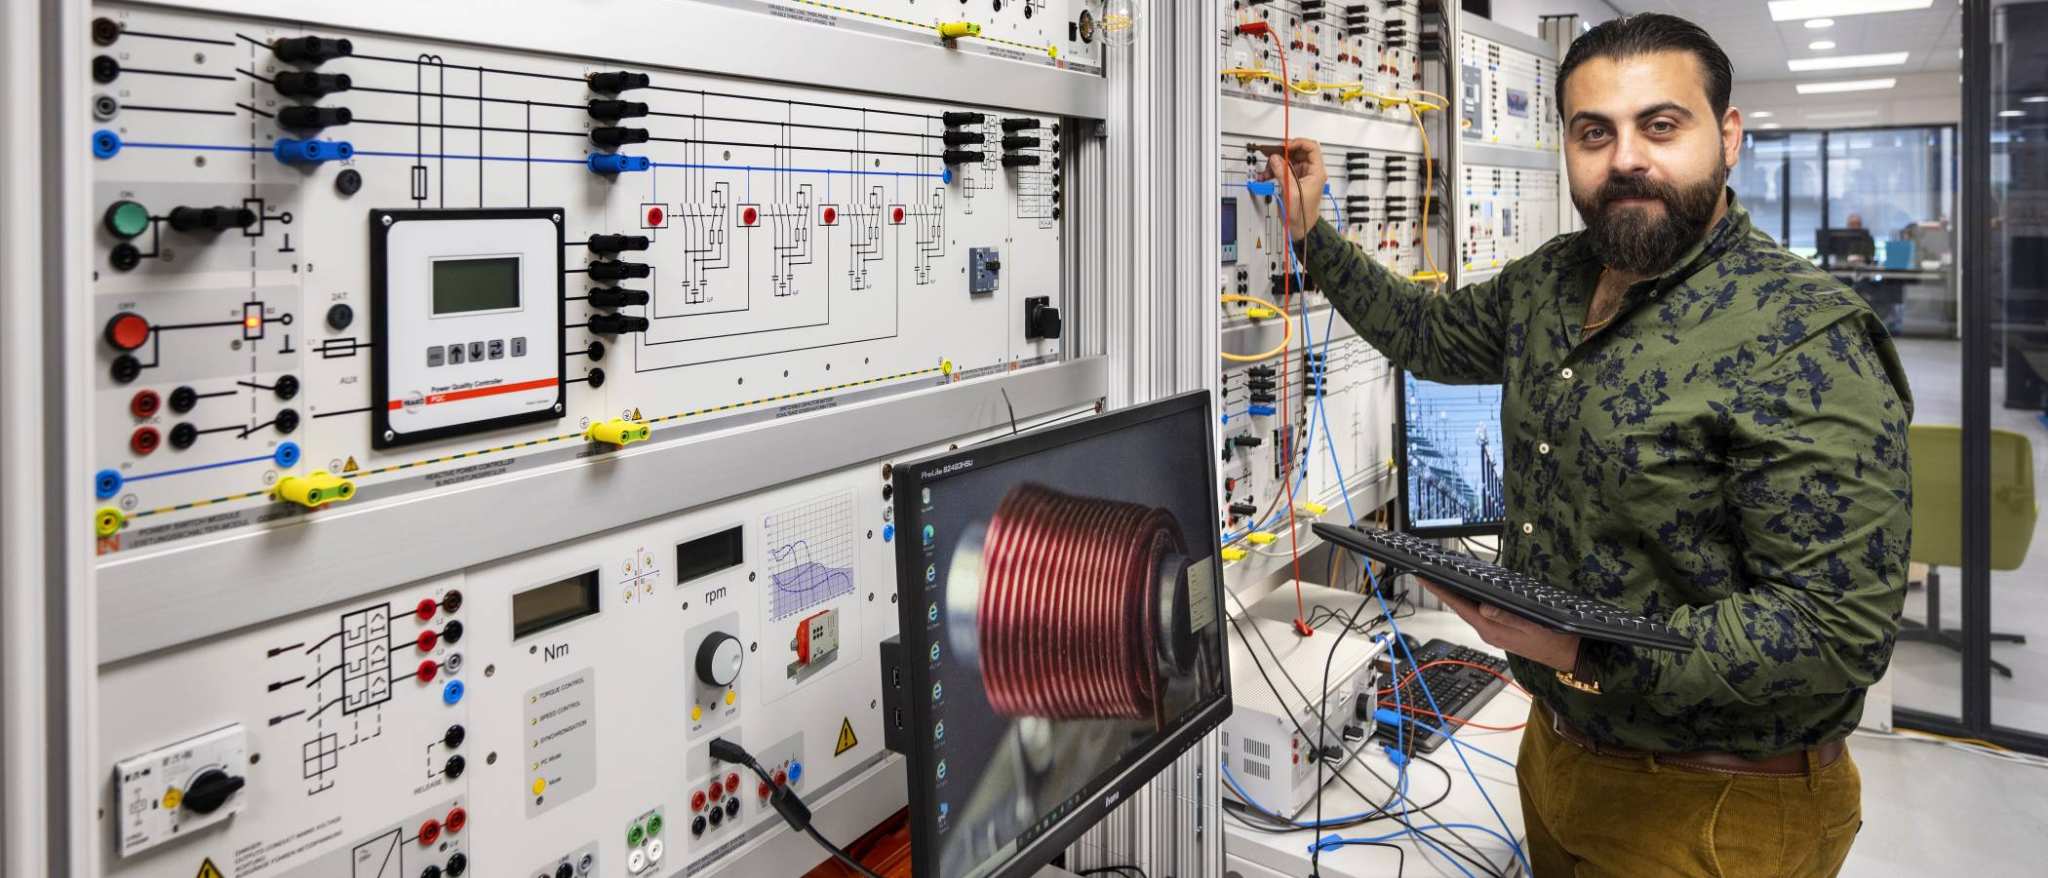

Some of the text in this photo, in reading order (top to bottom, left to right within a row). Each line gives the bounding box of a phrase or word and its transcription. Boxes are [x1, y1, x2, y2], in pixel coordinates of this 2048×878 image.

[452, 381, 474, 390] Quality
[474, 377, 504, 388] Controller
[207, 510, 241, 524] MODULE
[704, 585, 727, 606] rpm
[544, 641, 570, 663] Nm
